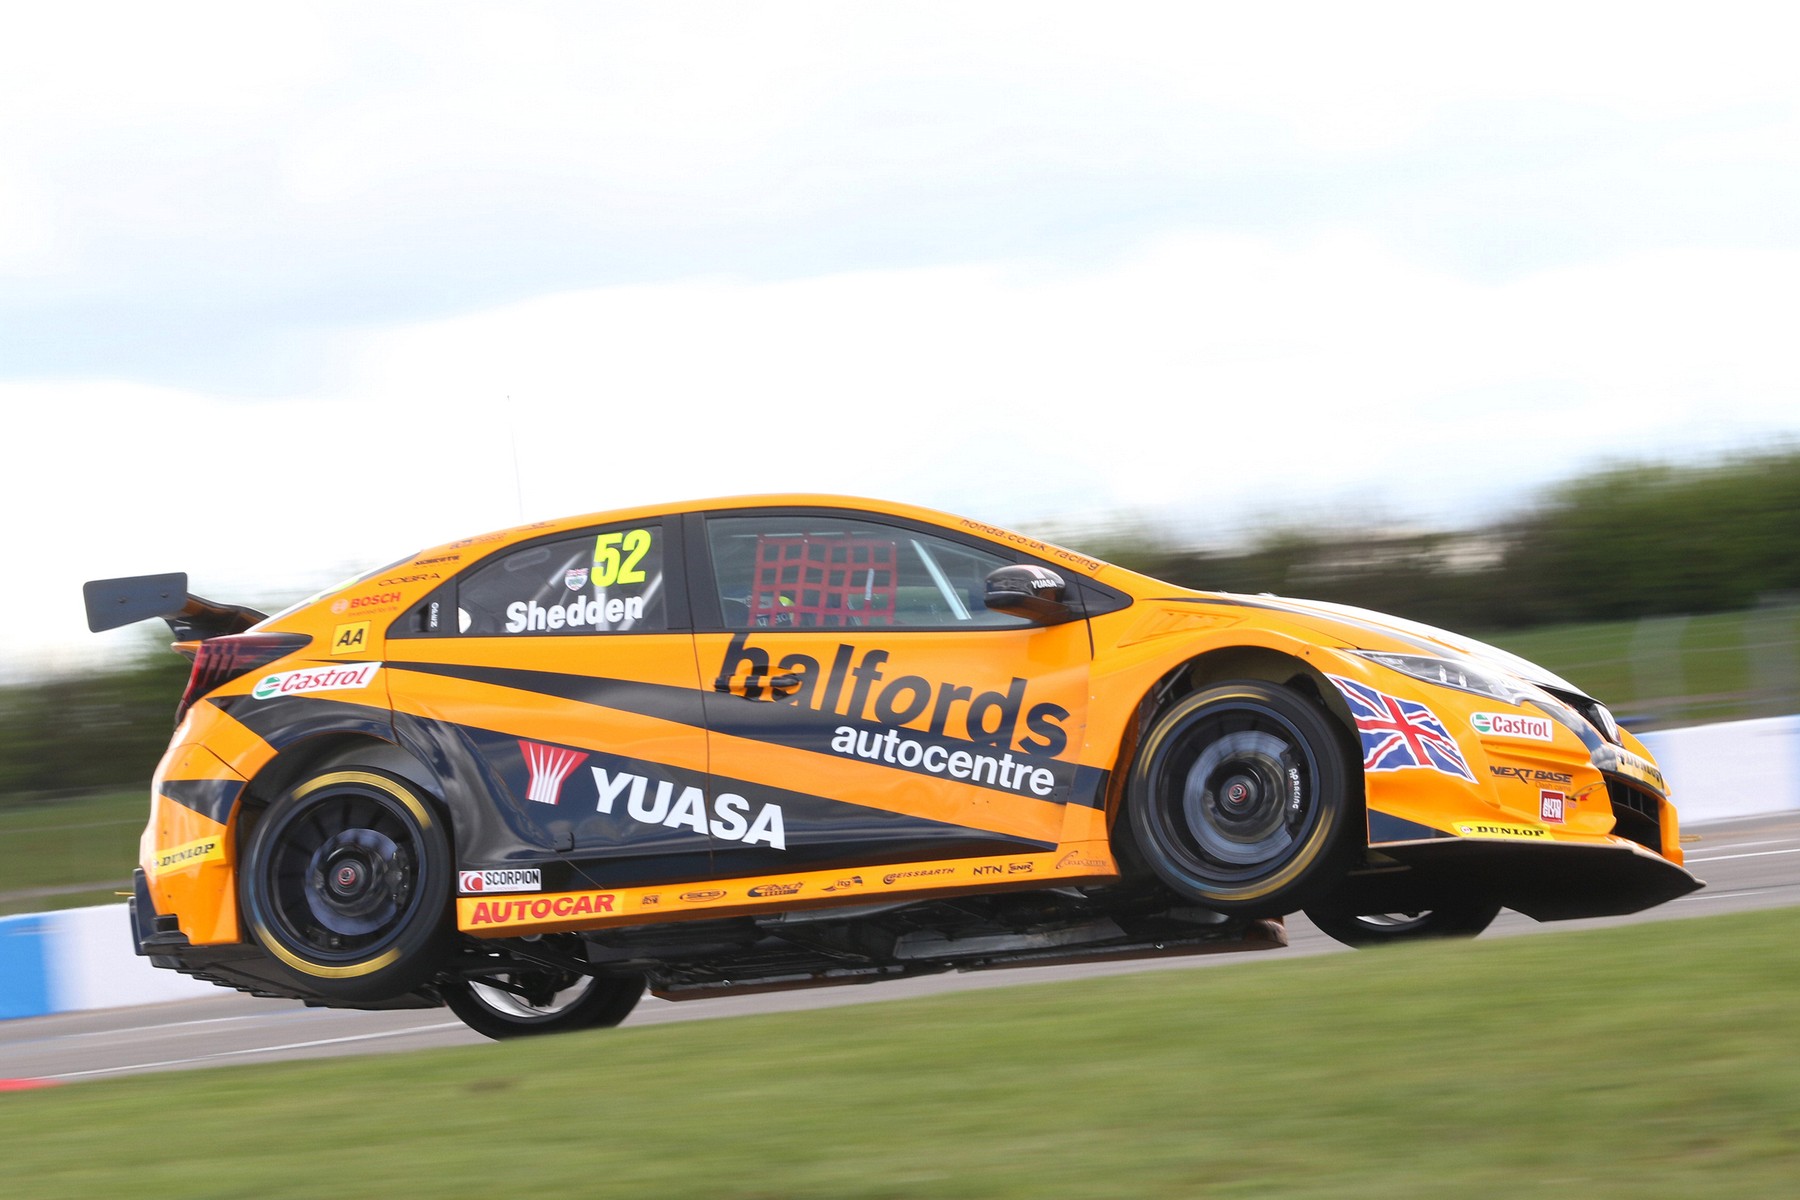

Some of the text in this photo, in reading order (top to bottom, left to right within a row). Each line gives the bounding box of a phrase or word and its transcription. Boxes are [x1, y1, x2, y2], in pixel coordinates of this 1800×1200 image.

[590, 529, 652, 587] 52
[1030, 580, 1057, 589] YUASA
[350, 592, 401, 608] BOSCH
[505, 593, 644, 634] Shedden
[336, 628, 364, 647] AA
[280, 666, 370, 692] Castrol
[718, 633, 1071, 758] halfords
[1492, 716, 1549, 737] Castrol
[831, 725, 1055, 796] autocentre
[590, 766, 786, 851] YUASA
[1477, 826, 1545, 837] DUNLOP
[160, 843, 216, 867] DUNLOP
[485, 870, 540, 886] SCORPION
[972, 864, 1032, 876] NTN SNR
[470, 894, 616, 925] AUTOCAR
